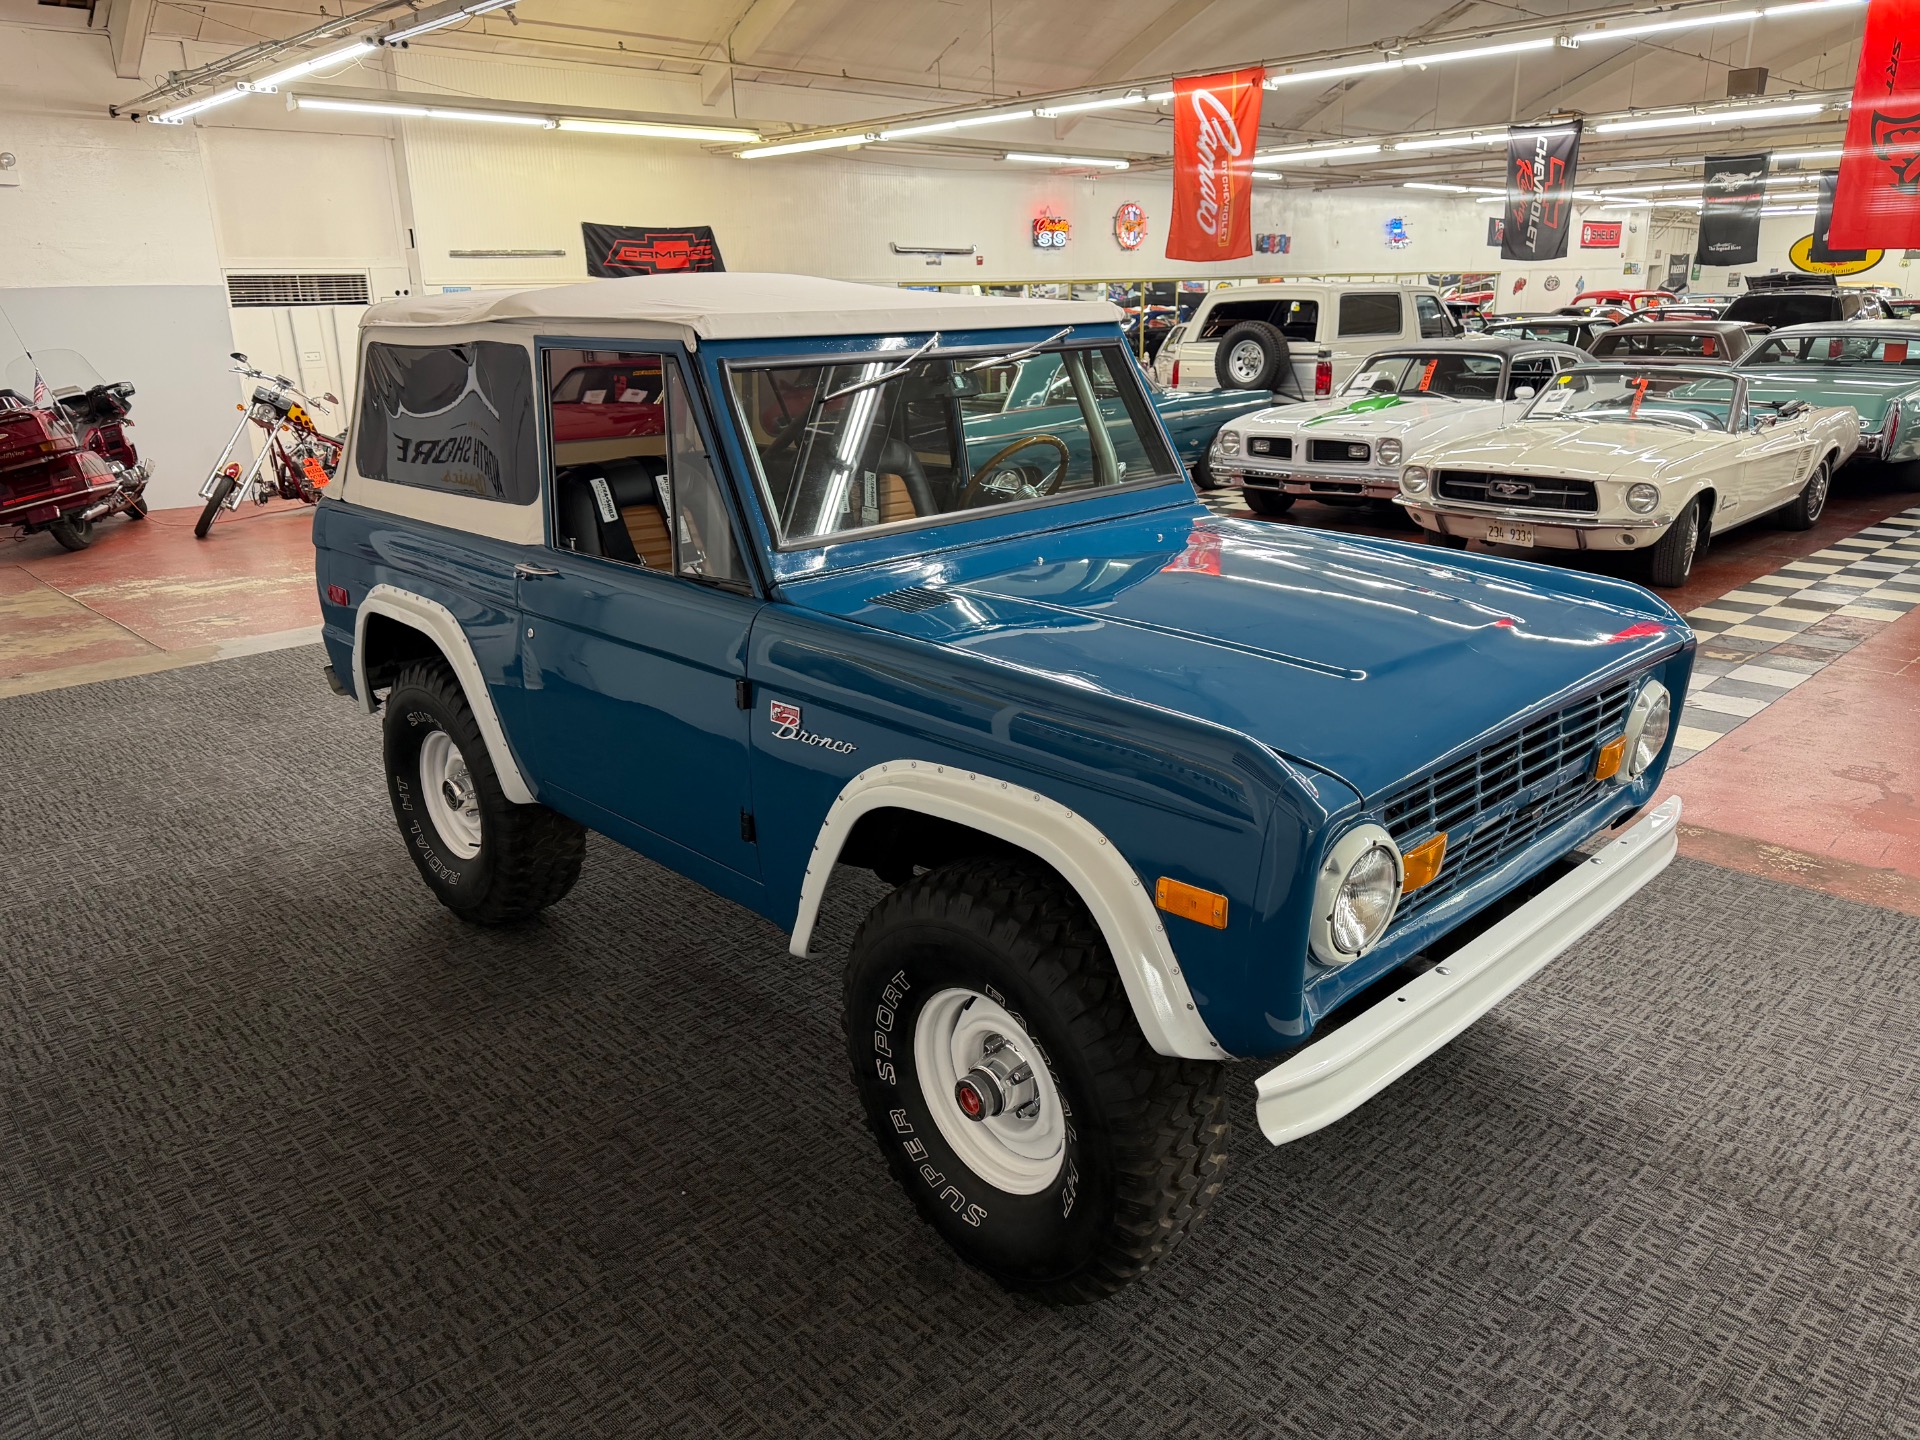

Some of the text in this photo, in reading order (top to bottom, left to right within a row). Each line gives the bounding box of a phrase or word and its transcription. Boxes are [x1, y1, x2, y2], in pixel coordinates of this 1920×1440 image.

[1885, 36, 1902, 96] SRT
[1191, 88, 1242, 235] Camaro
[1513, 158, 1535, 232] Racing
[1525, 135, 1548, 253] CHEVROLET
[1220, 160, 1230, 241] BY CHEVROLET
[1591, 229, 1619, 240] SHELBY
[1037, 231, 1066, 247] SS
[771, 713, 857, 754] Bronco
[410, 819, 461, 885] RADIAL
[874, 969, 988, 1228] SUPER SPORT
